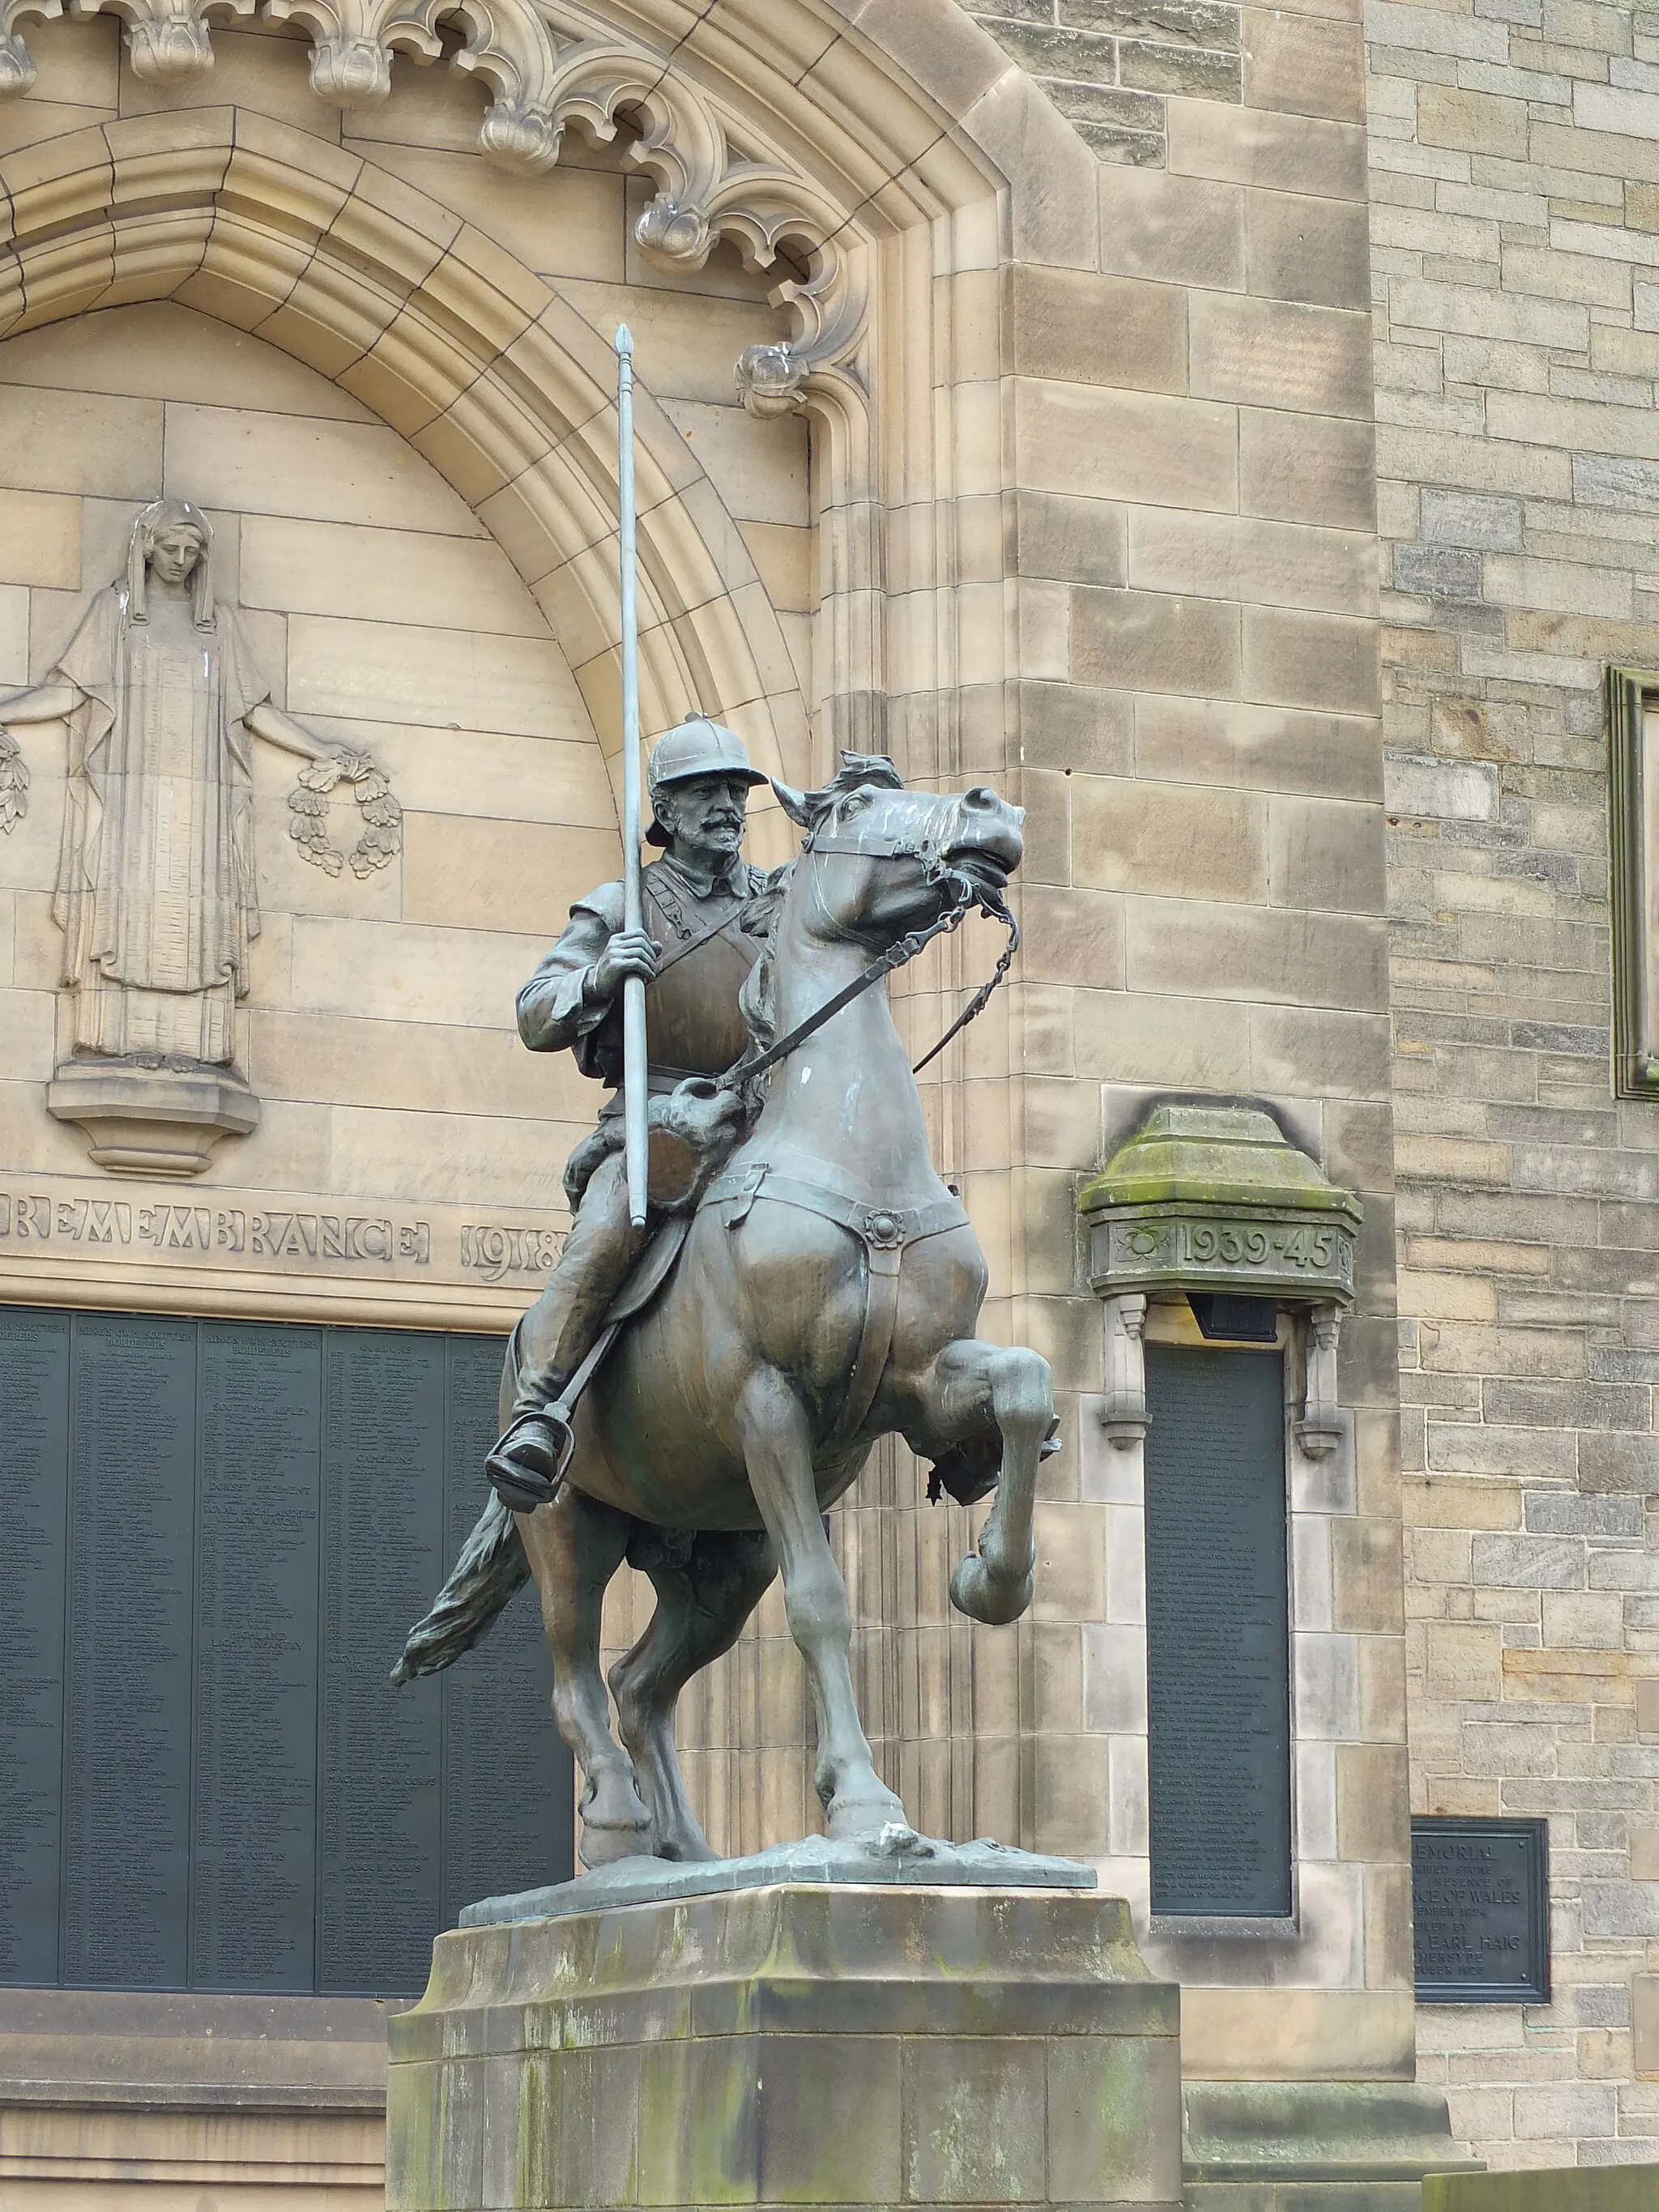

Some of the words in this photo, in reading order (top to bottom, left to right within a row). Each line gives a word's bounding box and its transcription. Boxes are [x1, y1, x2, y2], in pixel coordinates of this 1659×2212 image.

[9, 1194, 426, 1263] REMEMBRANCE
[463, 1225, 561, 1281] 1918
[1180, 1222, 1335, 1268] 1939-45
[143, 1329, 195, 1342] SCOTTISH
[106, 1337, 168, 1350] BORDERERS
[268, 1337, 318, 1349] SCOTTISH
[232, 1345, 292, 1357] BORDERERS
[213, 1402, 266, 1413] SCOTTISH
[1411, 1843, 1499, 1860] EMORIAL
[1443, 1890, 1465, 1903] OF
[1469, 1890, 1520, 1904] WALES
[1428, 1934, 1473, 1950] EARL
[1479, 1934, 1521, 1950] HAIG
